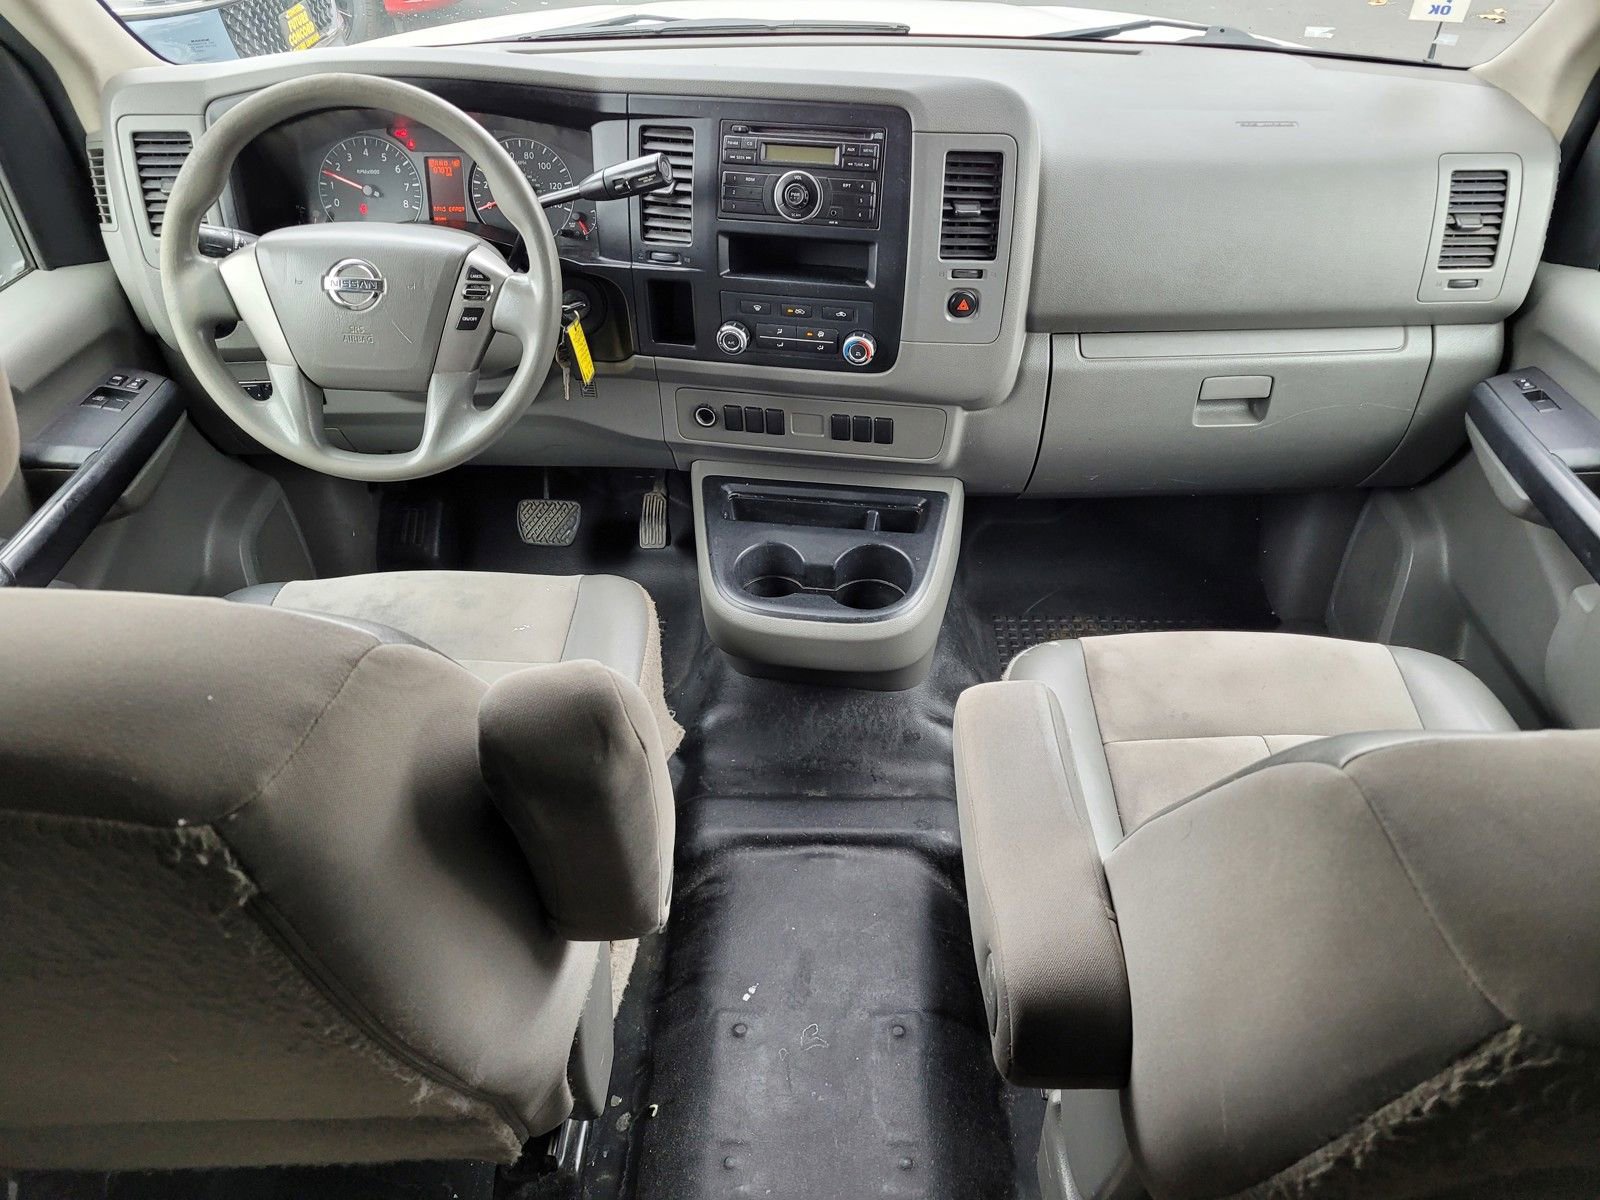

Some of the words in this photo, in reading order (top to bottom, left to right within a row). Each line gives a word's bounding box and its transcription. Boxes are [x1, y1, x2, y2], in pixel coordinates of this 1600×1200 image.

[1428, 4, 1452, 15] OK
[363, 148, 369, 156] 4
[523, 152, 535, 160] 80
[347, 153, 352, 161] 3
[381, 153, 387, 161] 5
[335, 163, 341, 171] 2
[395, 165, 401, 173] 6
[537, 162, 552, 170] 100
[404, 183, 409, 191] 7
[549, 182, 562, 190] 120
[334, 198, 340, 207] 0
[403, 199, 409, 208] 8
[331, 279, 378, 290] NISSAN
